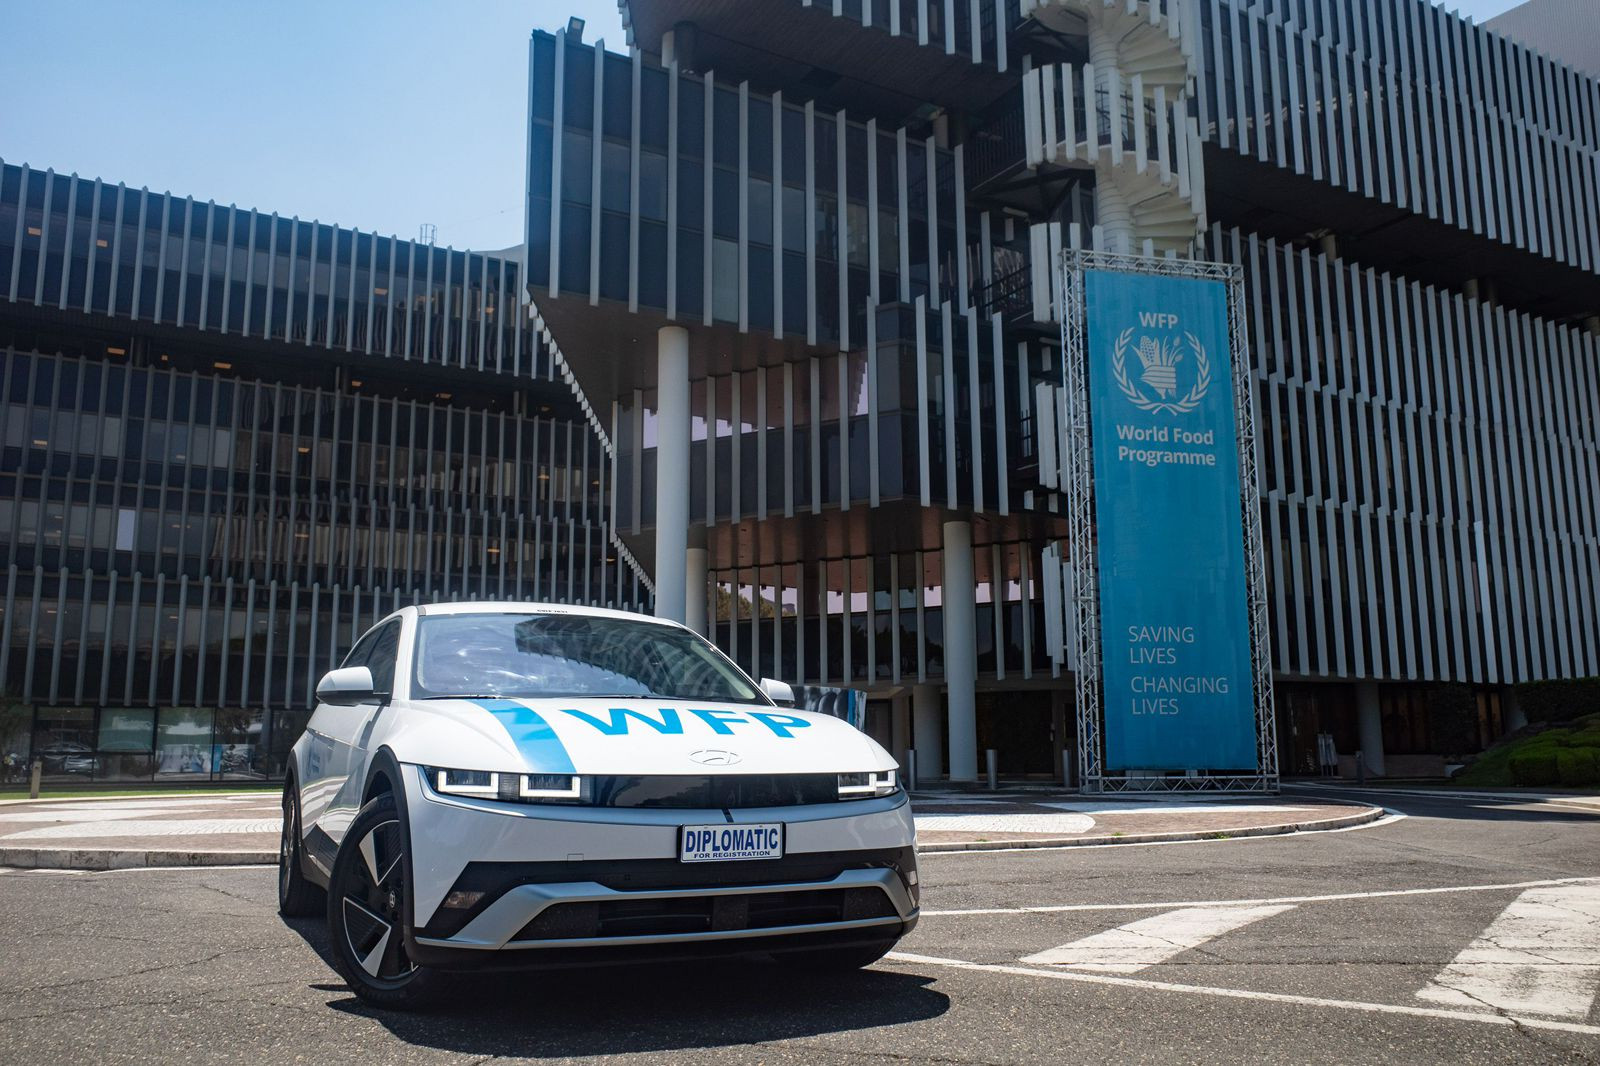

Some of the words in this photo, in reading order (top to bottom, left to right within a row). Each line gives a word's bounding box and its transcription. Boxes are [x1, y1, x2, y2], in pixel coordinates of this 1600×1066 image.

[1138, 311, 1179, 330] WFP
[1117, 425, 1169, 443] World
[1173, 428, 1214, 446] Food
[1117, 446, 1217, 468] Programme
[1128, 626, 1195, 643] SAVING
[1130, 647, 1177, 665] LIVES
[1130, 676, 1229, 694] CHANGING
[1132, 697, 1179, 715] LIVES
[560, 709, 811, 737] WFP
[685, 828, 777, 852] DIPLOMATIC
[713, 850, 771, 859] REGISTRATION
